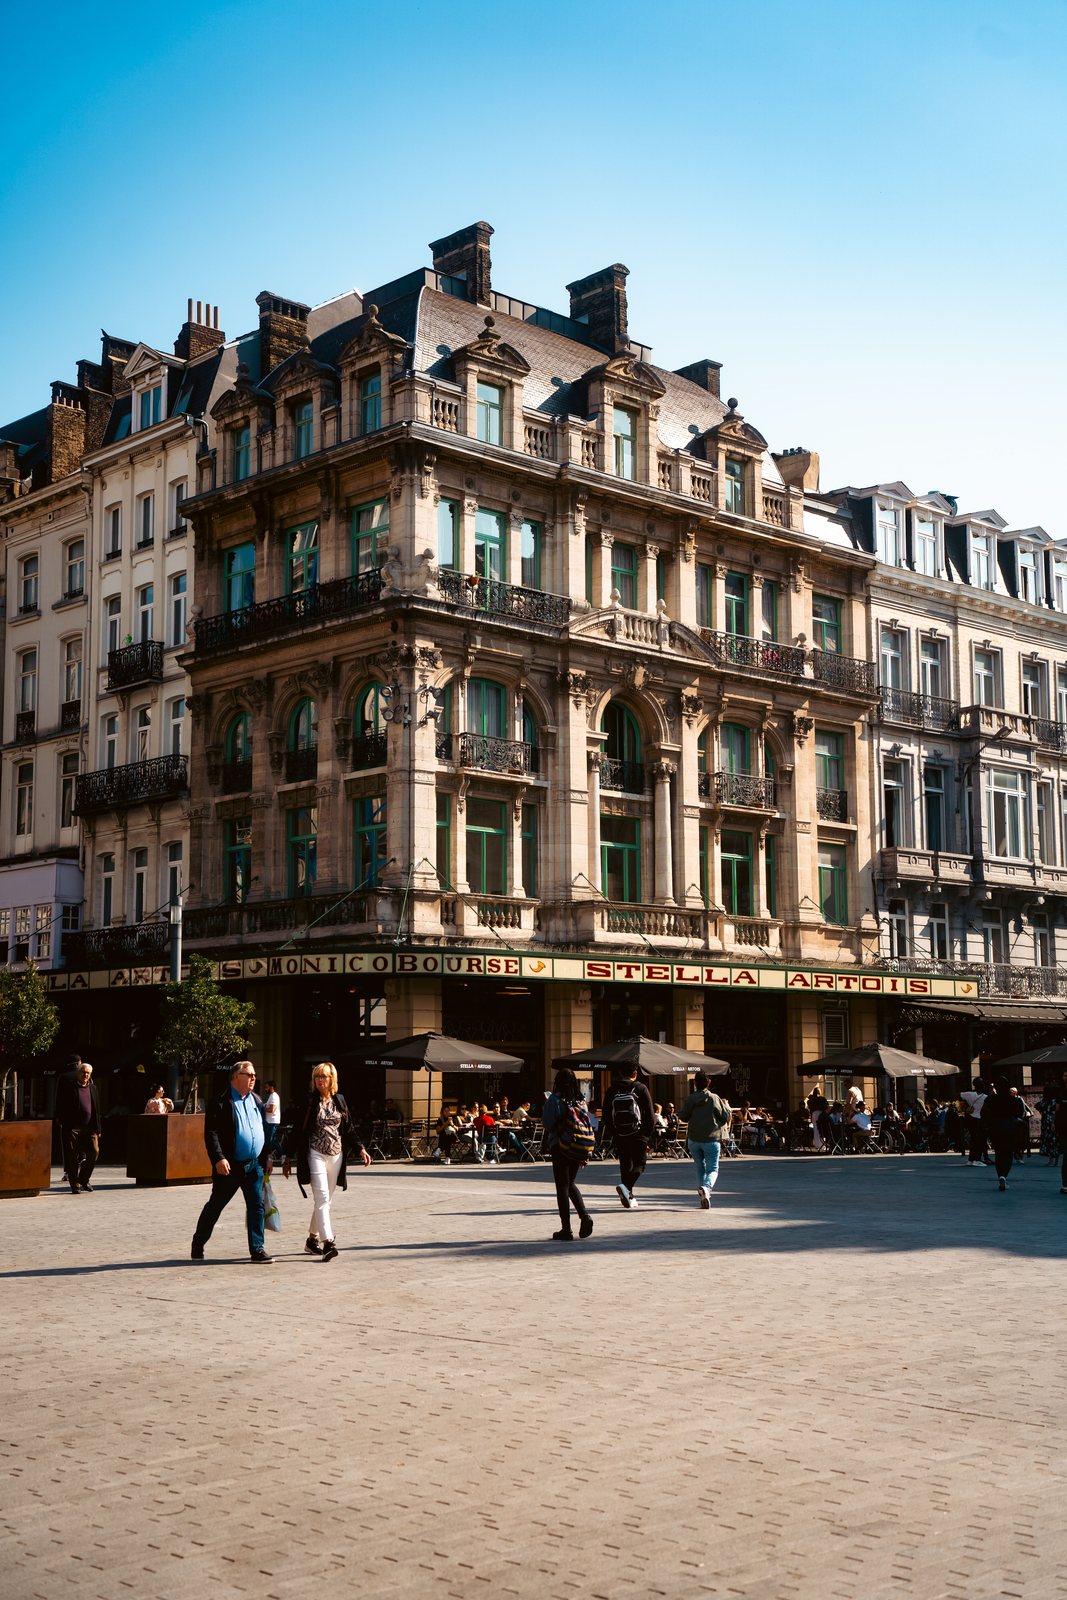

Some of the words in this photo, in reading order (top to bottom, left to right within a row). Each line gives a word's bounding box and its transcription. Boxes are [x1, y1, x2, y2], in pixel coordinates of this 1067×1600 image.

[270, 956, 388, 974] MONICO
[397, 954, 519, 975] BOURSE
[587, 962, 757, 985] STELLA
[788, 973, 928, 993] ARTOIS
